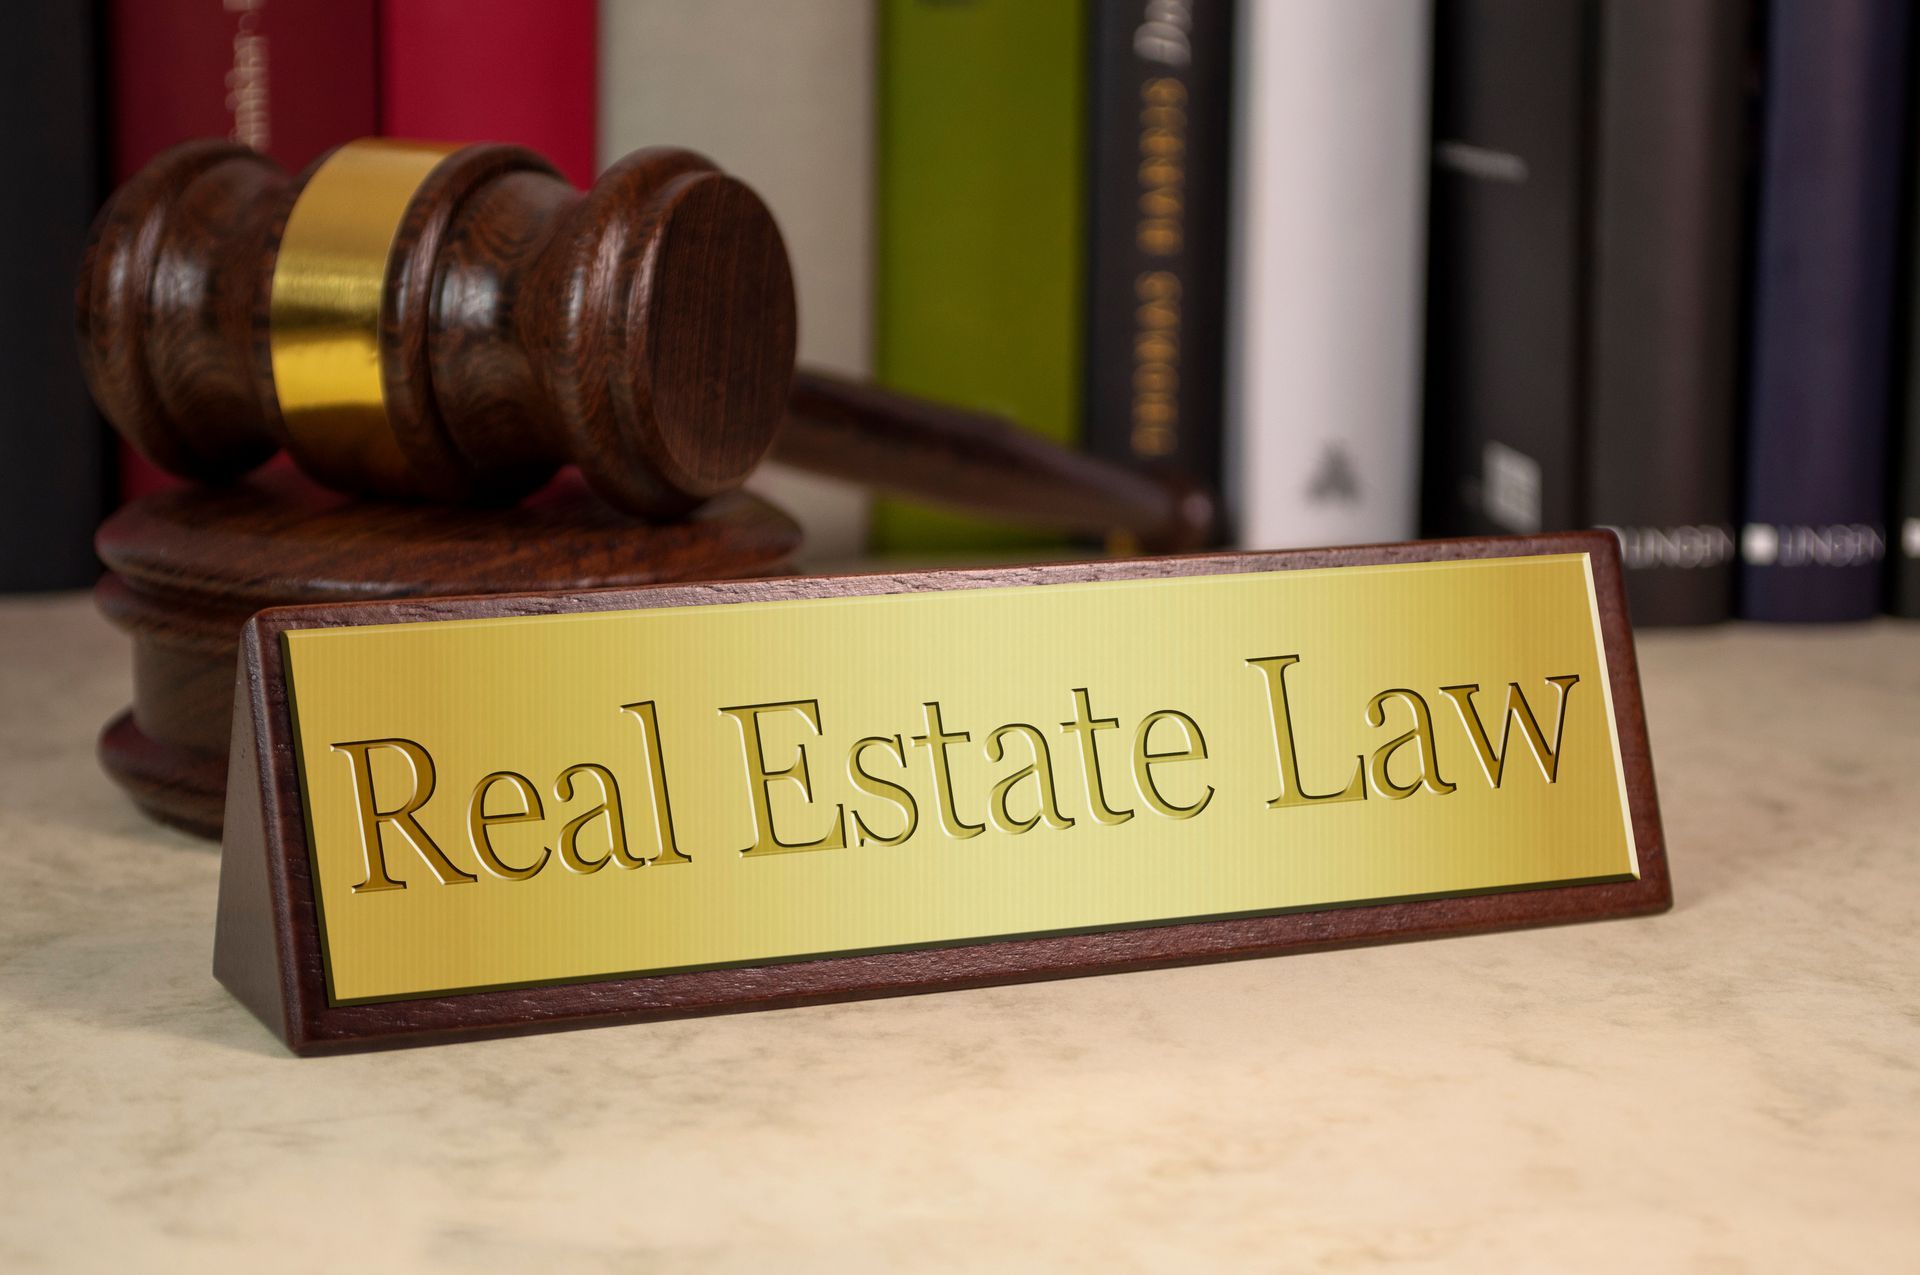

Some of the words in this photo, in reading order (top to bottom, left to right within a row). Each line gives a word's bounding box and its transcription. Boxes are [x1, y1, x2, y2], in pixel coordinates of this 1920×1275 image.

[330, 699, 692, 894] Real
[718, 686, 1216, 860] Estate
[1244, 652, 1581, 810] Law
